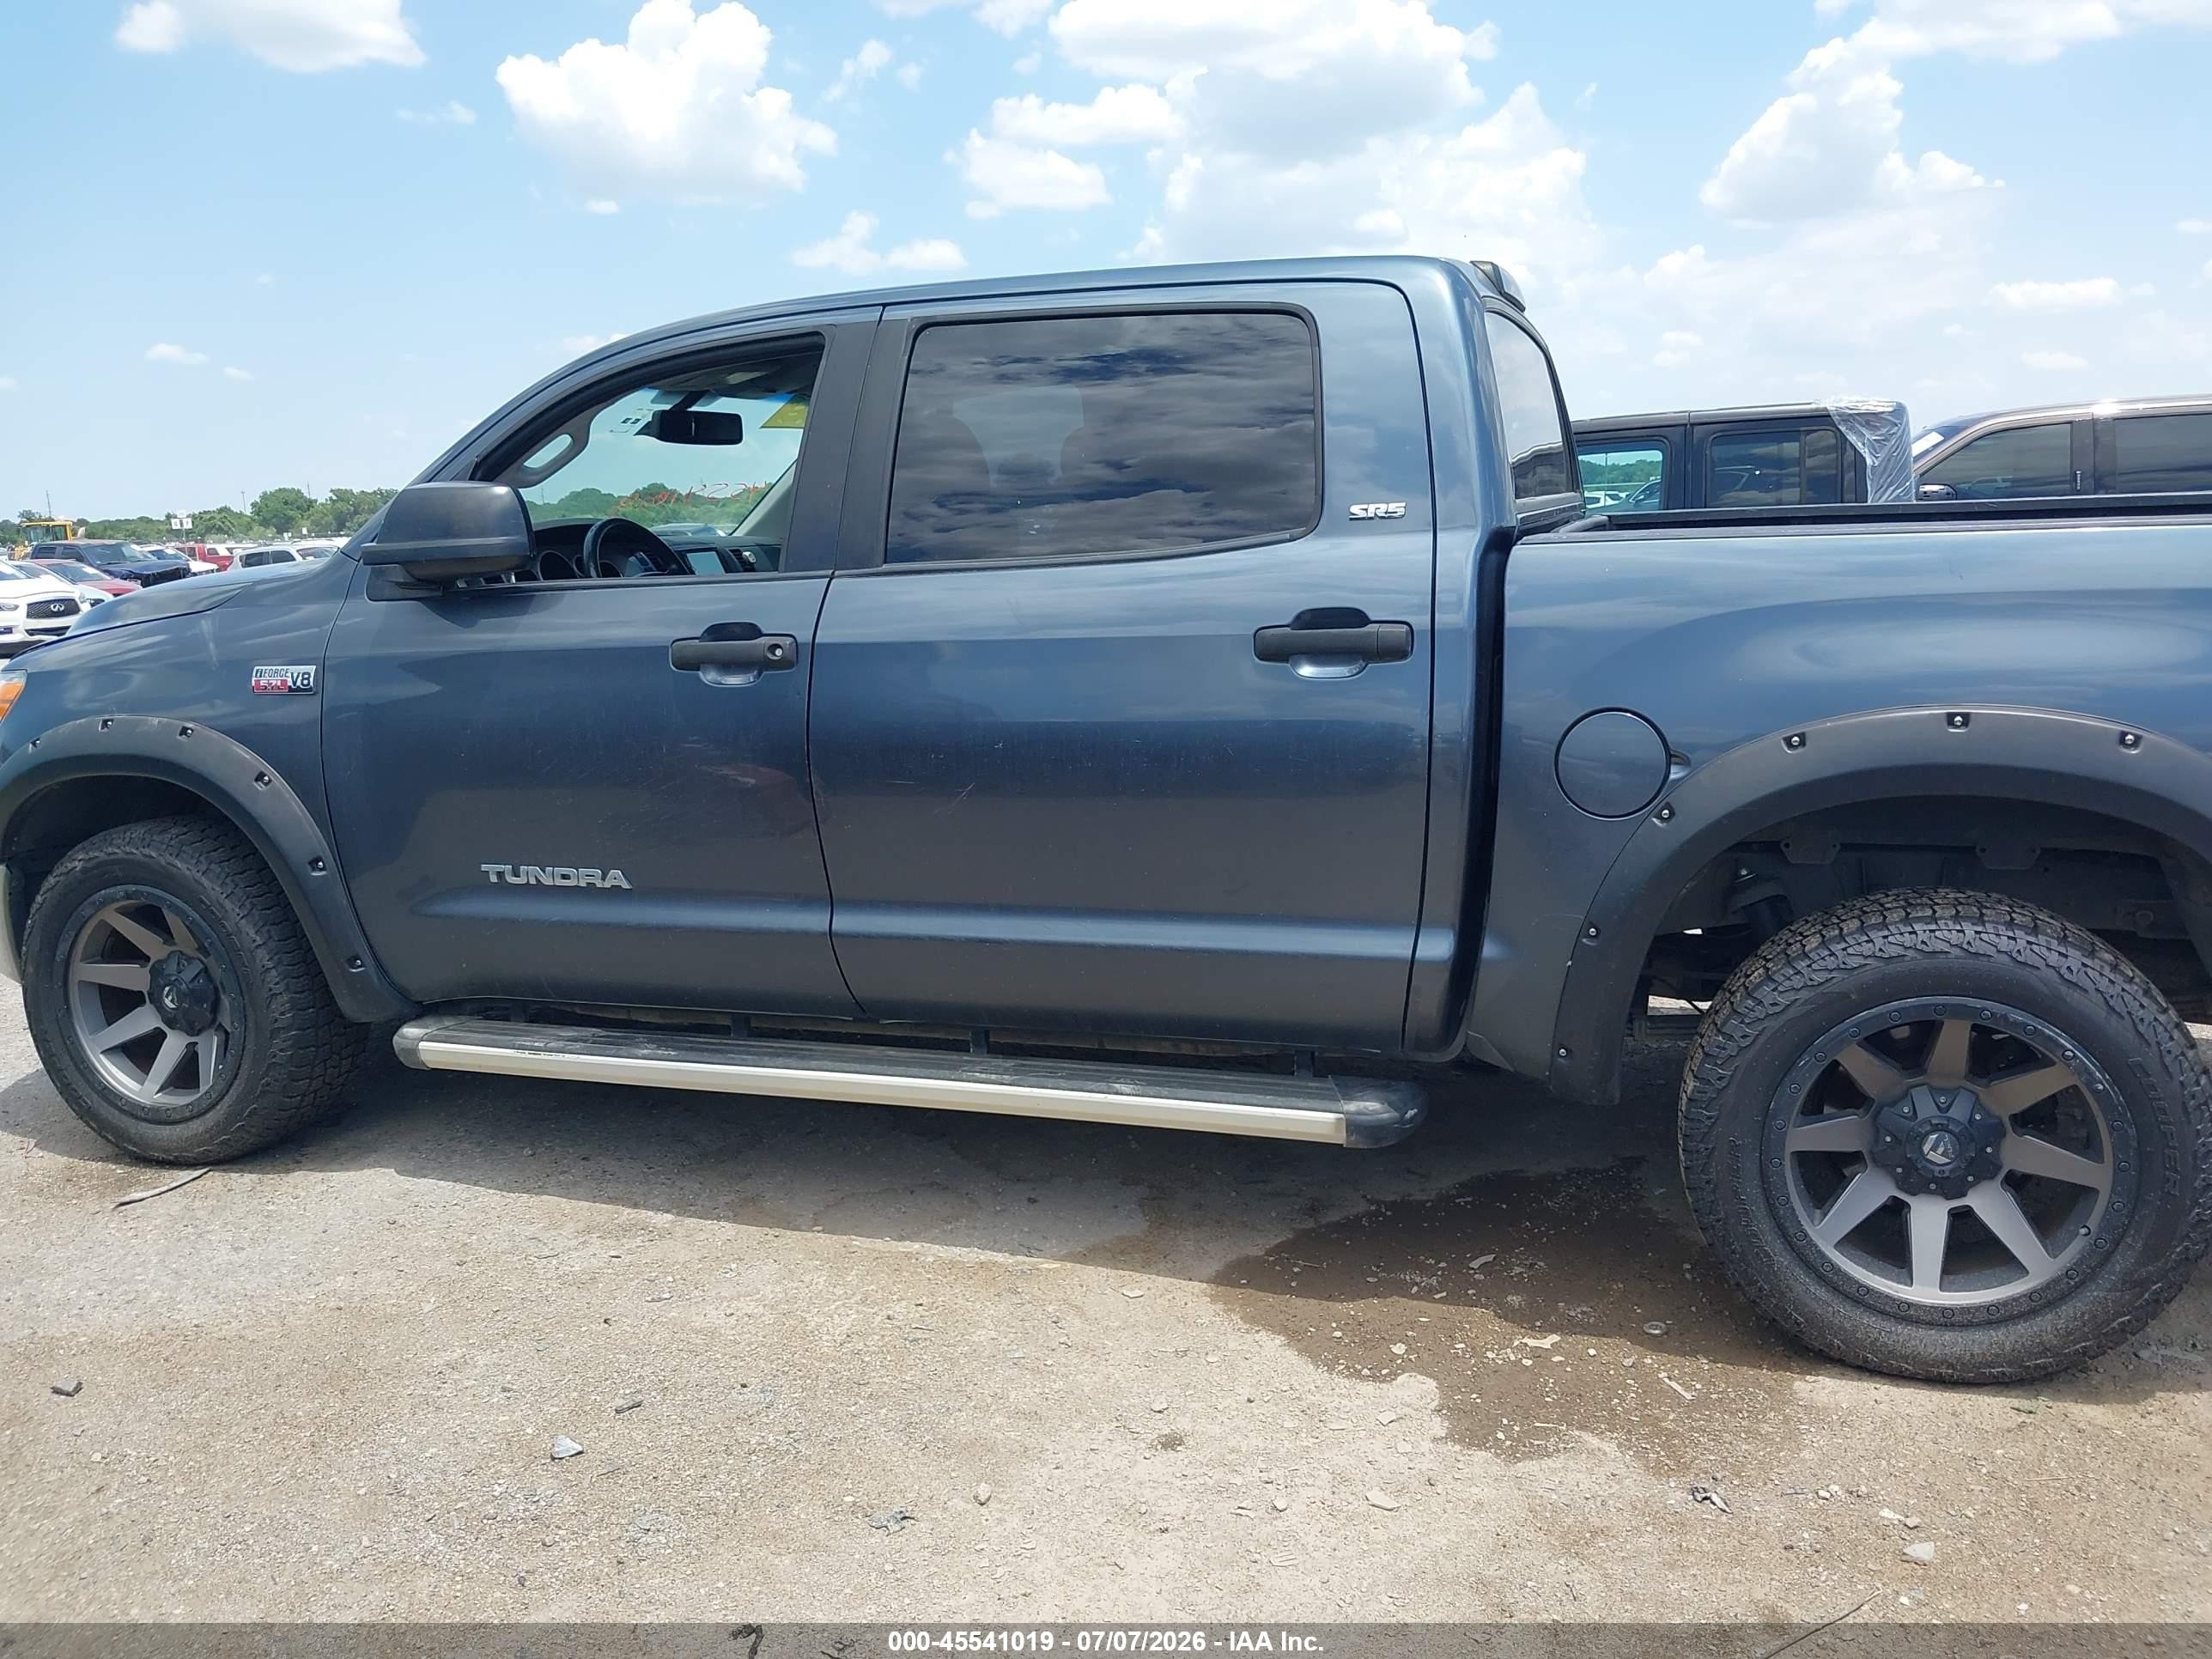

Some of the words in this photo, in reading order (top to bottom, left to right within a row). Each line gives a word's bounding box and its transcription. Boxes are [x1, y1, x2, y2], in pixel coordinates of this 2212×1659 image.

[1348, 501, 1407, 520] SR5
[289, 672, 313, 689] V8
[480, 864, 633, 890] TUNDRA
